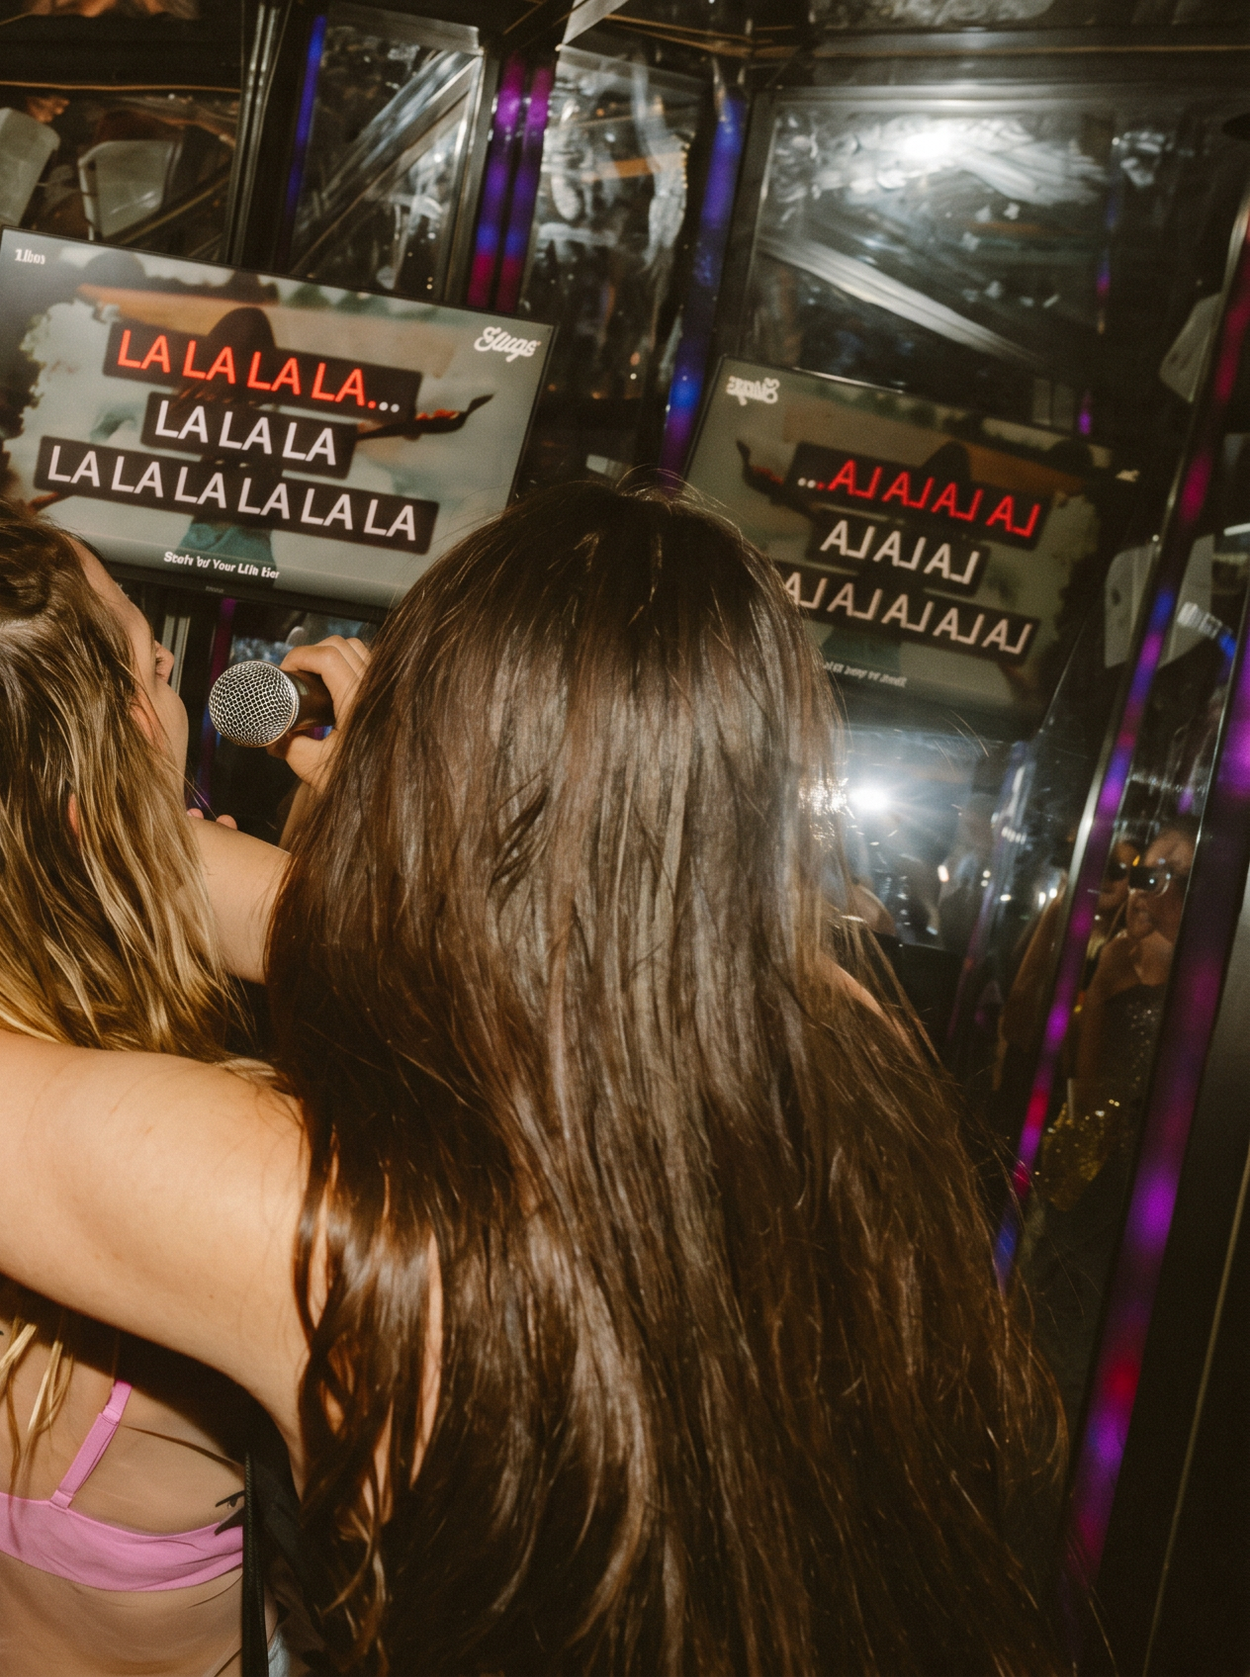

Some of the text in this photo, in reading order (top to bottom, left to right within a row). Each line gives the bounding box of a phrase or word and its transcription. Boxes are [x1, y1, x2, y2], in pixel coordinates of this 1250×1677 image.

[117, 329, 401, 414] LA LA LA LA...
[155, 400, 337, 465] LA LA LA
[47, 445, 416, 541] LA LA LA LA LA LA
[212, 559, 236, 573] Your
